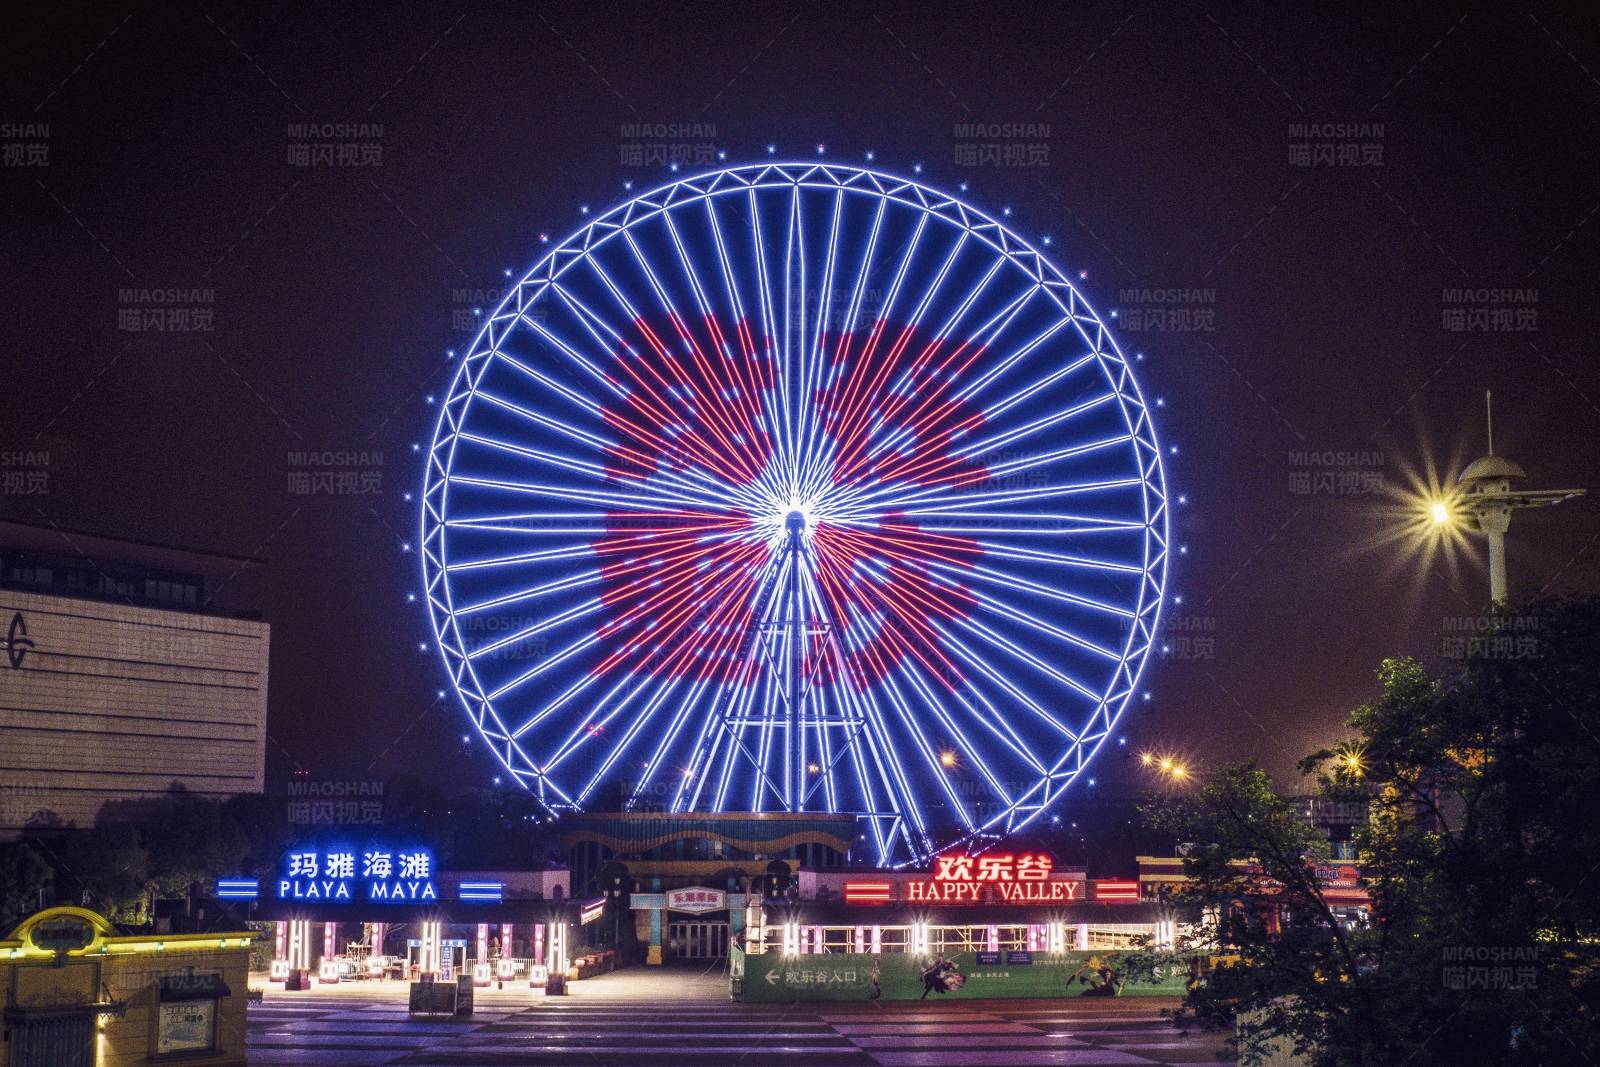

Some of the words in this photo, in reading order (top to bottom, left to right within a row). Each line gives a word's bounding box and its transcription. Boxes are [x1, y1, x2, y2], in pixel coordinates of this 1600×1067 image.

[289, 852, 430, 878] 玛雅海滩
[936, 857, 1052, 881] 欢乐谷
[280, 882, 350, 898] PLAYA
[371, 882, 435, 898] MAYA
[908, 883, 982, 900] HAPPY
[999, 883, 1077, 900] VALLEY
[785, 970, 857, 986] 欢乐谷入口
